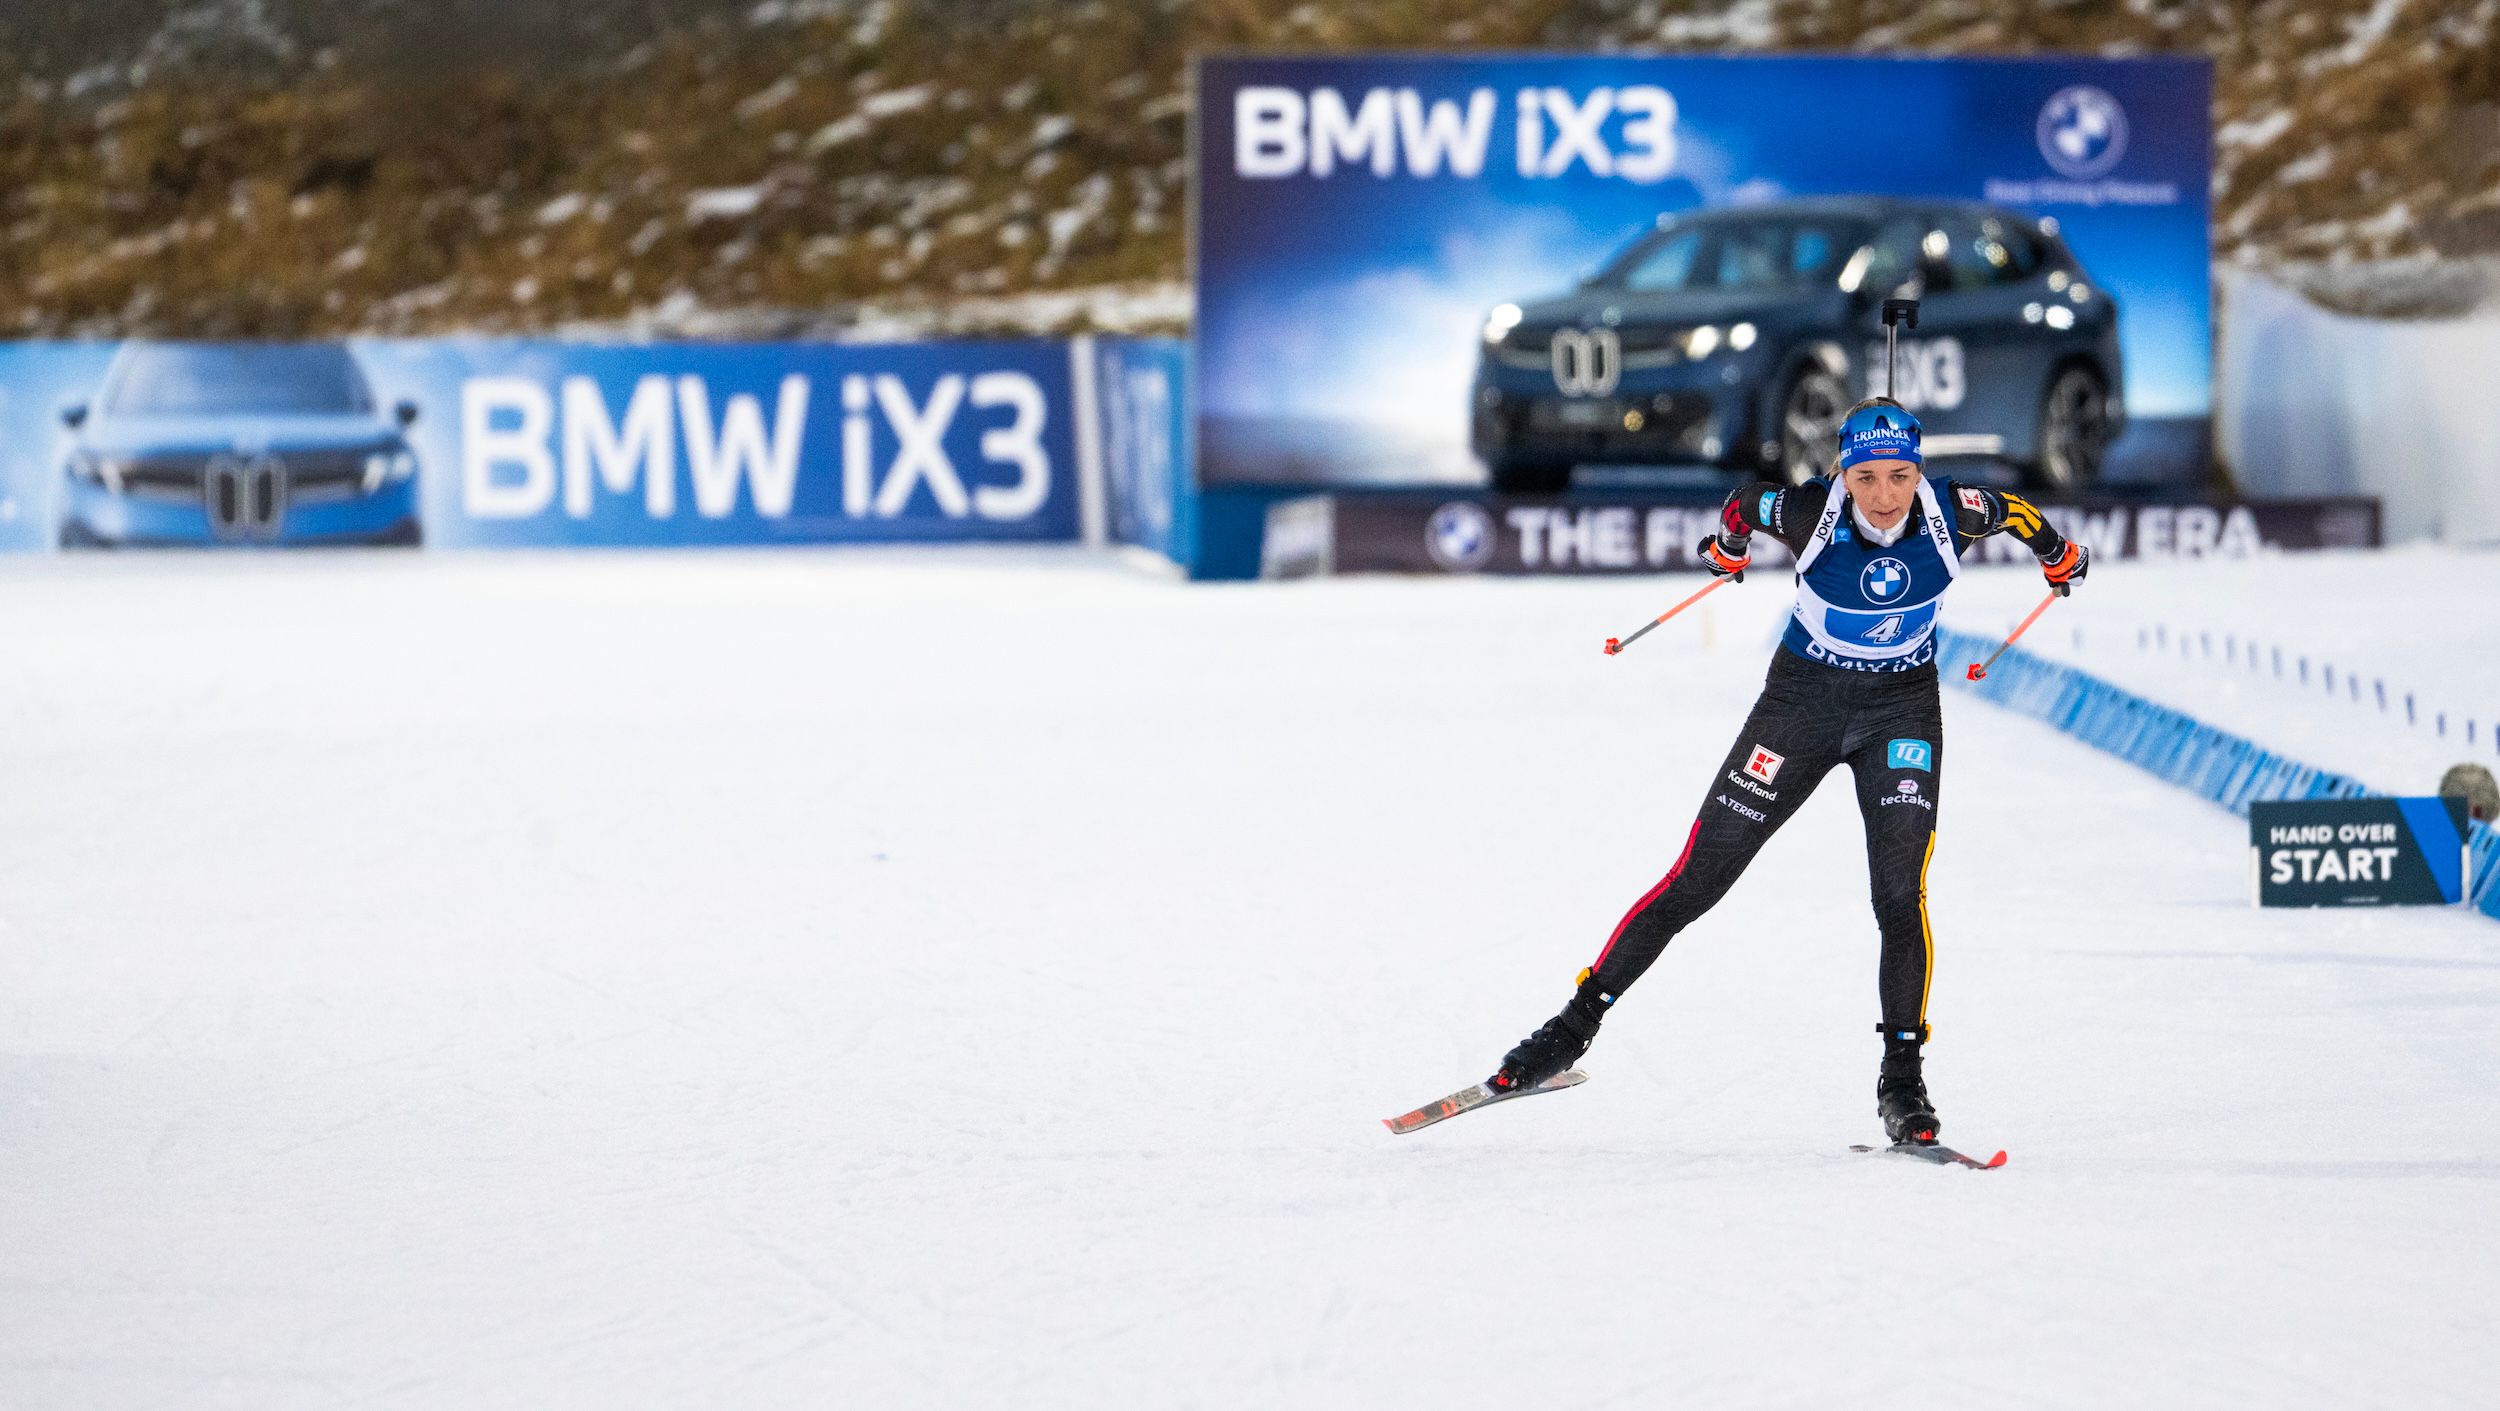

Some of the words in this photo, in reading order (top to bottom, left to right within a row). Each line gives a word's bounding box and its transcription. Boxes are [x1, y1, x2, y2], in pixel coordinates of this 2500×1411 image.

[1234, 86, 1497, 179] BMW
[1515, 84, 1677, 182] iX3
[462, 373, 809, 519] BMW
[842, 372, 1050, 520] iX3
[1853, 428, 1911, 442] ERDINGER
[1505, 507, 1638, 566] THE
[1816, 510, 1837, 541] JOKA
[1929, 515, 1948, 546] JOKA
[1867, 560, 1903, 574] BMW
[1861, 614, 1905, 644] 4
[1728, 769, 1778, 801] Kaufland
[1728, 798, 1767, 823] TERREX
[1881, 794, 1931, 810] tectake
[2271, 826, 2333, 844] HAND
[2339, 824, 2396, 843] OVER
[2271, 848, 2398, 884] START
